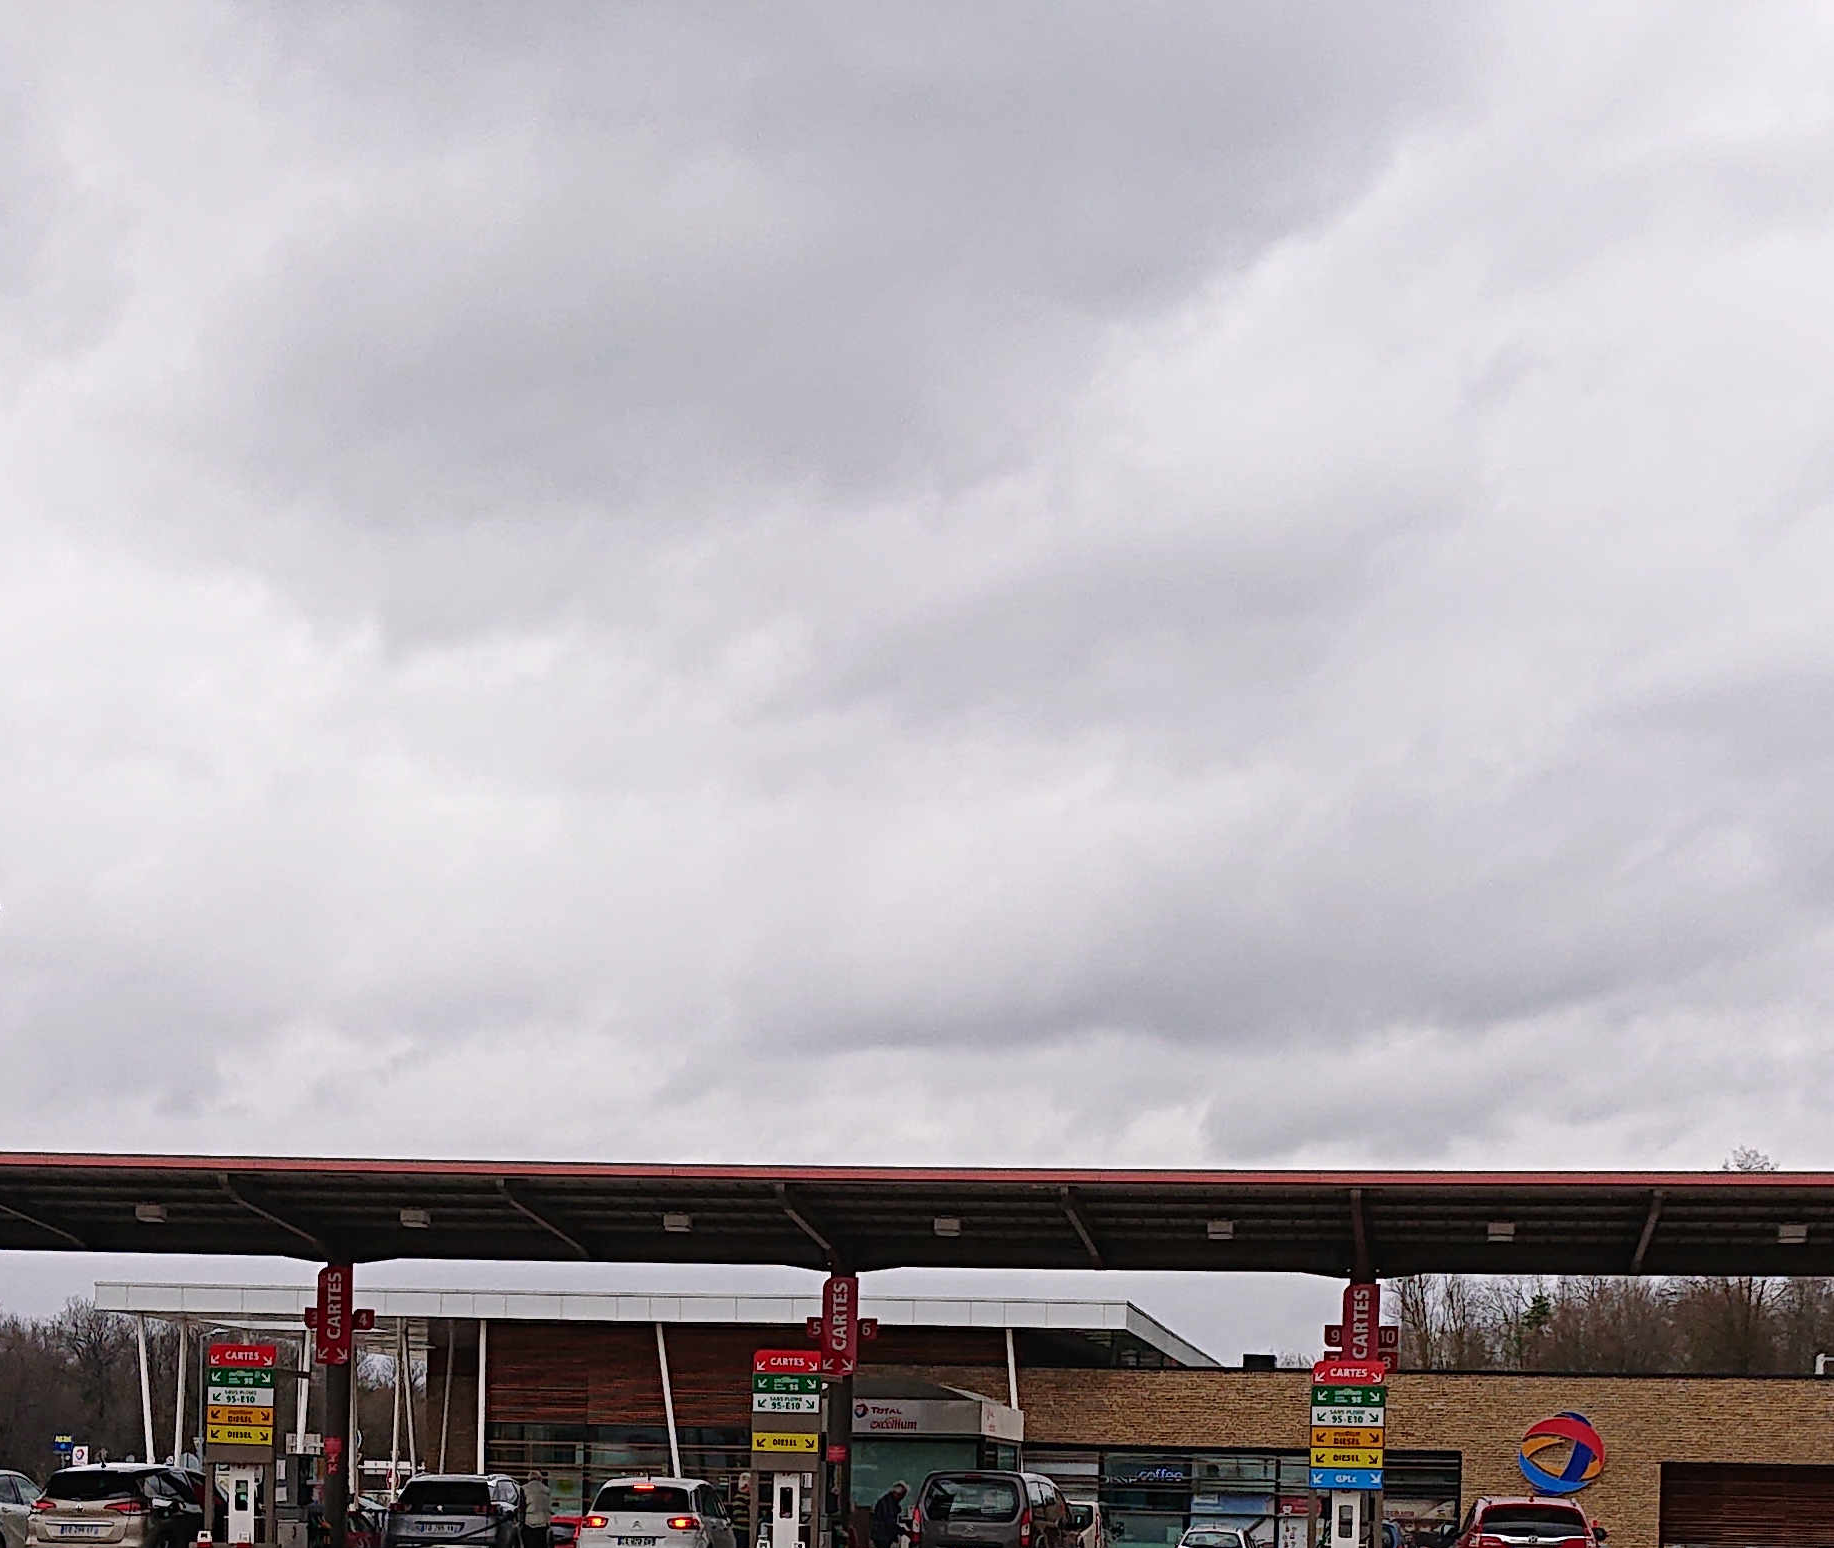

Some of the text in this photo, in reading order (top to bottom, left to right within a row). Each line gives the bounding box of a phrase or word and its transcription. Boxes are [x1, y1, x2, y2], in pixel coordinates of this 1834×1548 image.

[326, 1272, 342, 1339] CARTES
[831, 1282, 848, 1351] CARTES
[812, 1321, 821, 1335] 5
[862, 1323, 871, 1336] 6
[1352, 1289, 1370, 1359] CARTES
[1331, 1329, 1340, 1343] 9
[1380, 1330, 1396, 1344] 10
[225, 1350, 259, 1360] CARTES
[770, 1357, 805, 1366] CARTES
[1330, 1368, 1367, 1378] CARTES
[871, 1406, 903, 1415] TOTAL
[227, 1431, 252, 1439] DIESEL
[1333, 1454, 1360, 1462] DIESEL
[1139, 1469, 1183, 1482] coffee
